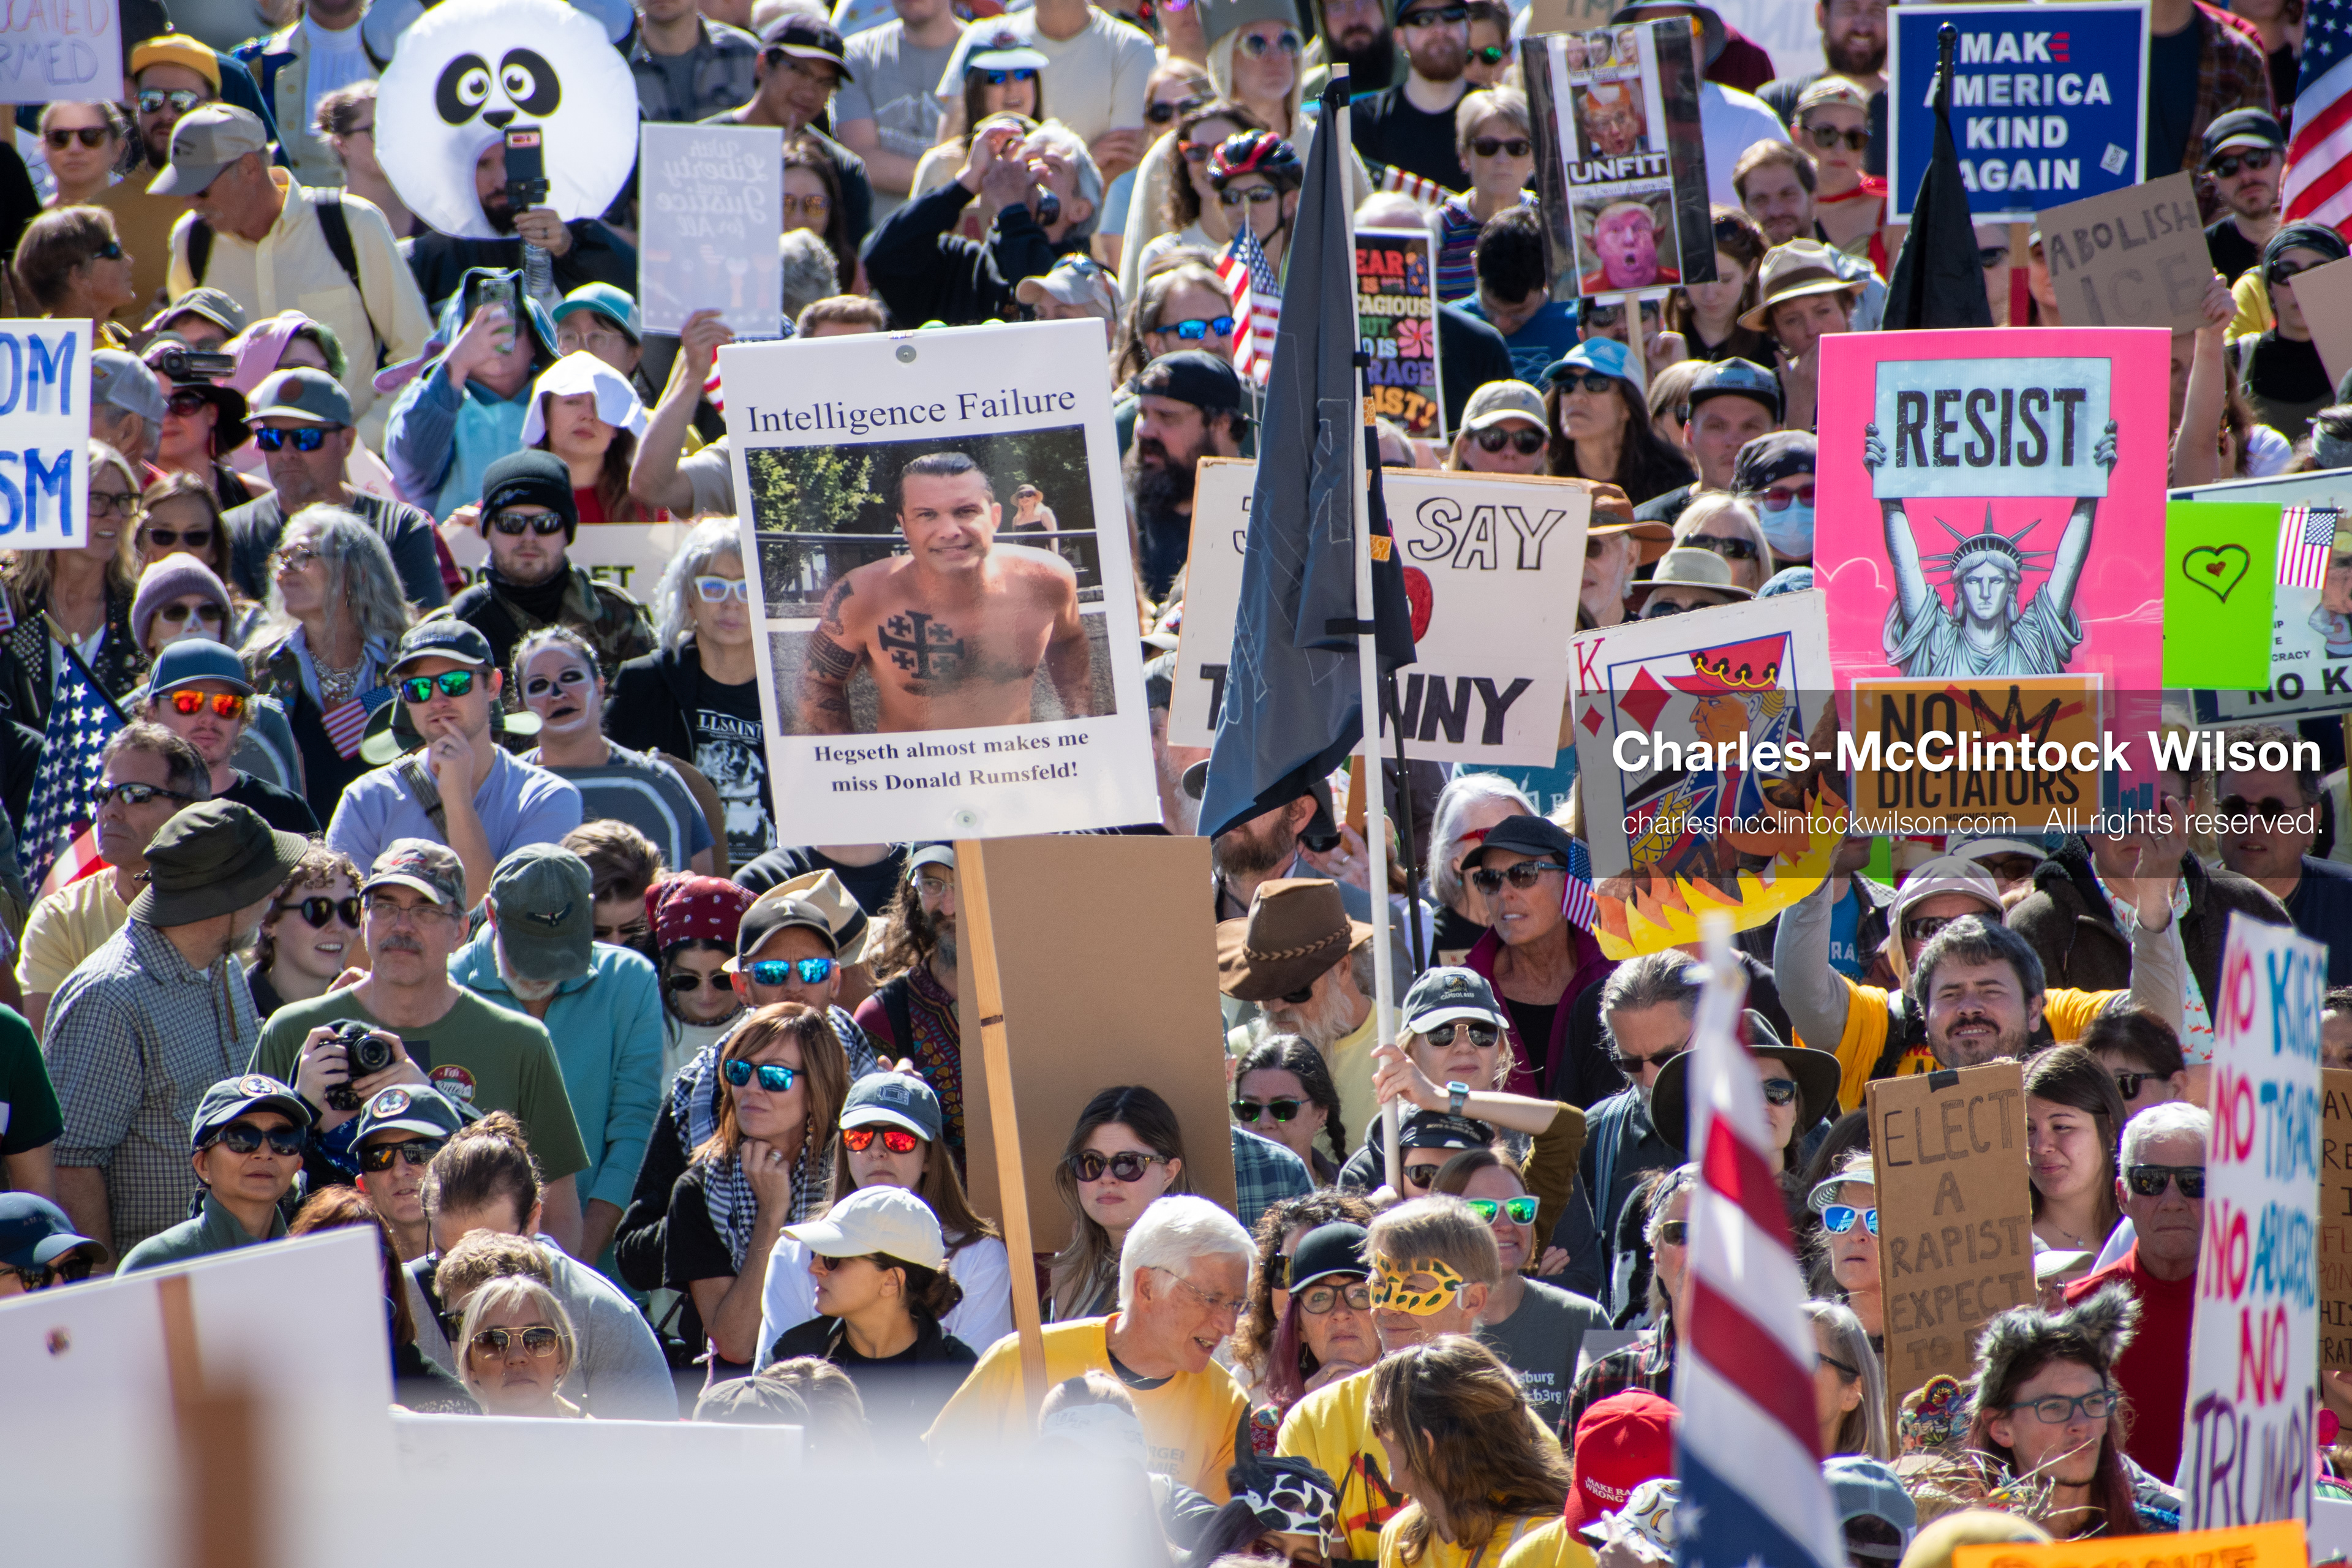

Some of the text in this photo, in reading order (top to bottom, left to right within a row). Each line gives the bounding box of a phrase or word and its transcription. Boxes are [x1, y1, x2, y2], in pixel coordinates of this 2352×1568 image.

[1961, 31, 2070, 64] MAKE
[1966, 115, 2068, 149] KIND
[1569, 154, 1665, 185] UNFIT
[1959, 158, 2081, 192] AGAIN
[2050, 200, 2198, 276] ABOLISH
[2081, 252, 2205, 326] ICE
[745, 388, 1076, 435] Intelligence Failure
[1896, 387, 2087, 468] RESIST
[1408, 497, 1567, 570] SAY
[1574, 637, 1607, 697] K
[814, 732, 1089, 766] Hegseth almost makes me
[1880, 693, 1958, 758] NO
[831, 760, 1078, 792] miss Donald Rumsfeld!
[1878, 761, 2080, 810] DICTATORS
[1885, 1089, 2018, 1166] ELECT
[2211, 1066, 2255, 1163] NO
[1933, 1171, 1965, 1216] A
[1890, 1215, 2025, 1278] RAPIST
[2204, 1199, 2248, 1303] NO
[1891, 1271, 2026, 1334] EXPECT
[1906, 1335, 1954, 1370] TO
[2237, 1302, 2288, 1407] NO
[1585, 1480, 1624, 1503] WRONG
[1586, 1476, 1614, 1494] MAKE
